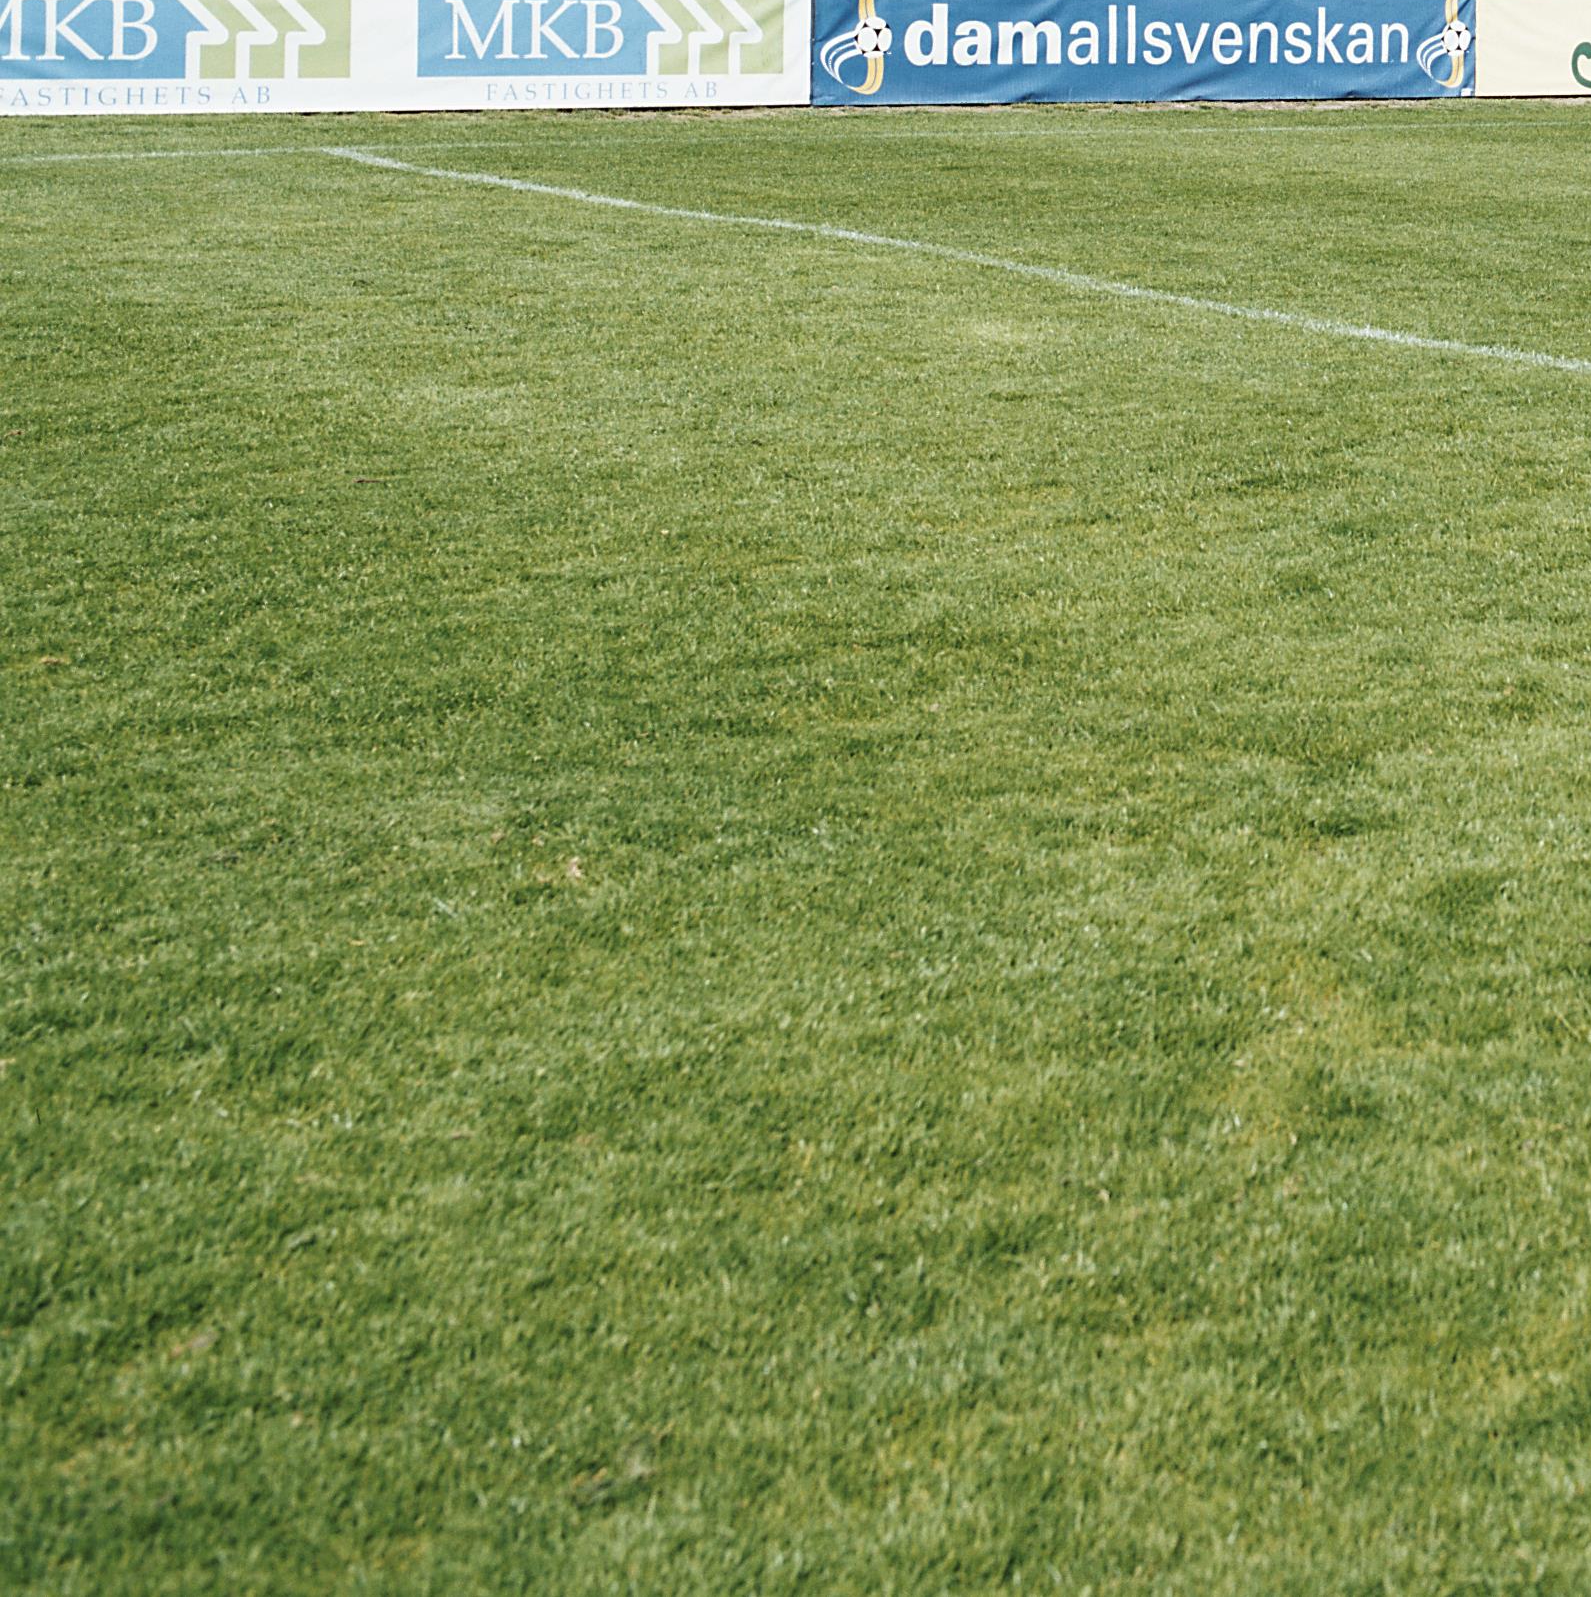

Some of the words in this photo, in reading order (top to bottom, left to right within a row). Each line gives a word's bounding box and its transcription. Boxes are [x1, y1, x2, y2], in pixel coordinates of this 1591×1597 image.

[904, 2, 1409, 66] damallsvenskan
[0, 86, 212, 107] ASTIGHETS
[231, 85, 271, 105] AB
[486, 81, 669, 102] FASTIGHETS
[683, 81, 718, 100] AB
